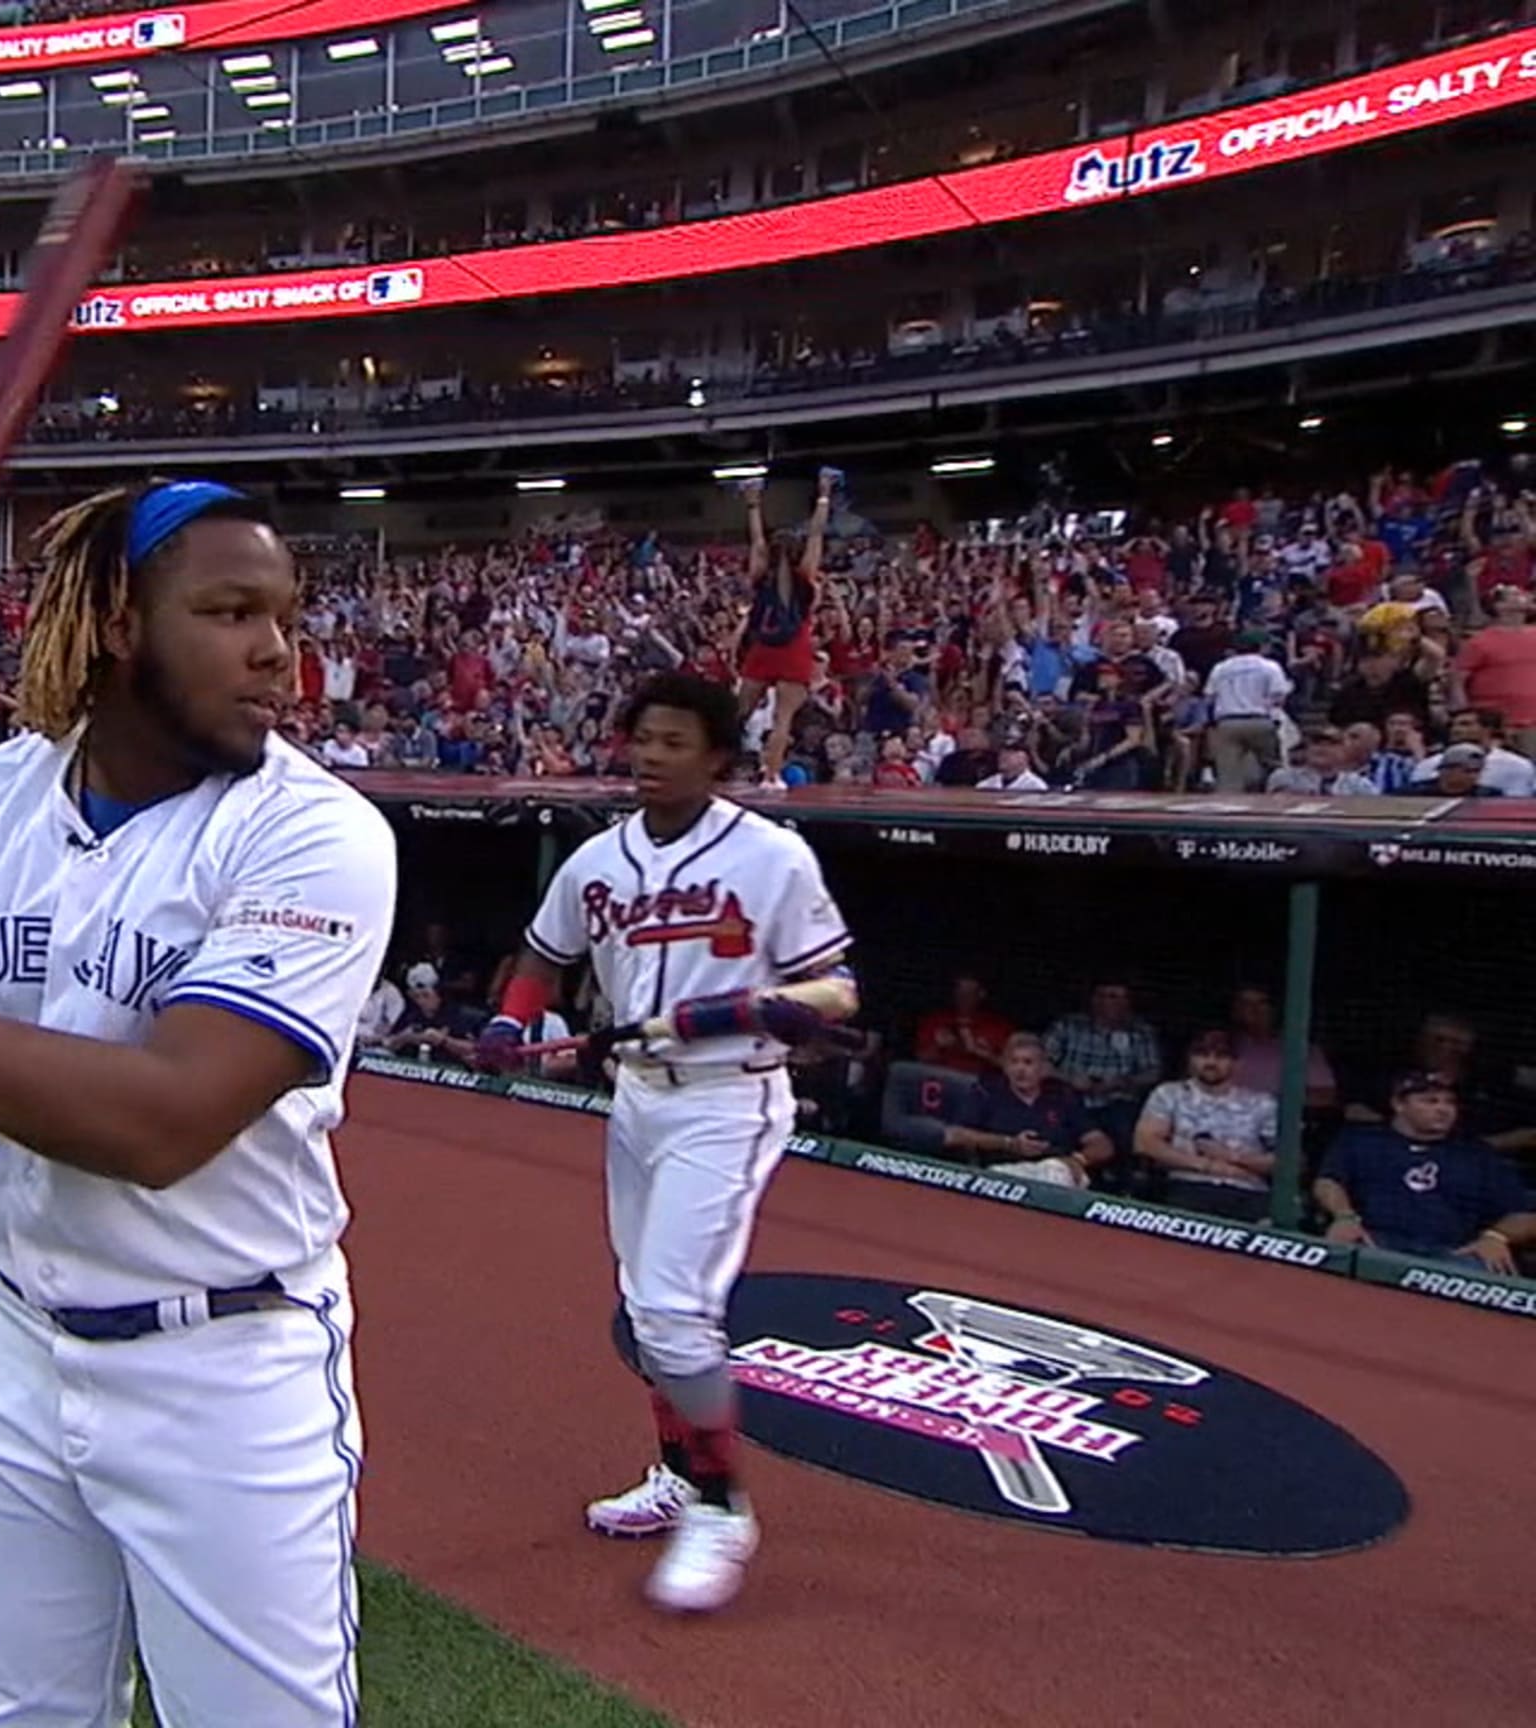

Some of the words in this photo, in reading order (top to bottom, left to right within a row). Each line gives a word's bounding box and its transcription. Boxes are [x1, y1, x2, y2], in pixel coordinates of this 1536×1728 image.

[44, 30, 104, 54] SNACK
[107, 26, 133, 47] OF
[1220, 96, 1378, 156] OFFICIAL
[1388, 56, 1512, 114] SALTY
[131, 296, 210, 317] OFFICIAL
[214, 290, 270, 311] SALTY
[273, 284, 337, 308] SNACK
[339, 281, 366, 301] OF
[1401, 848, 1441, 863] MLB
[583, 879, 721, 944] Braves
[855, 1152, 972, 1191] PROGRESSIVE
[968, 1174, 1028, 1202] FIELD
[1084, 1200, 1249, 1251] PROGRESSIVE
[1246, 1234, 1329, 1268] FIELD
[752, 1342, 893, 1390] RUN
[910, 1379, 1123, 1453] HOME
